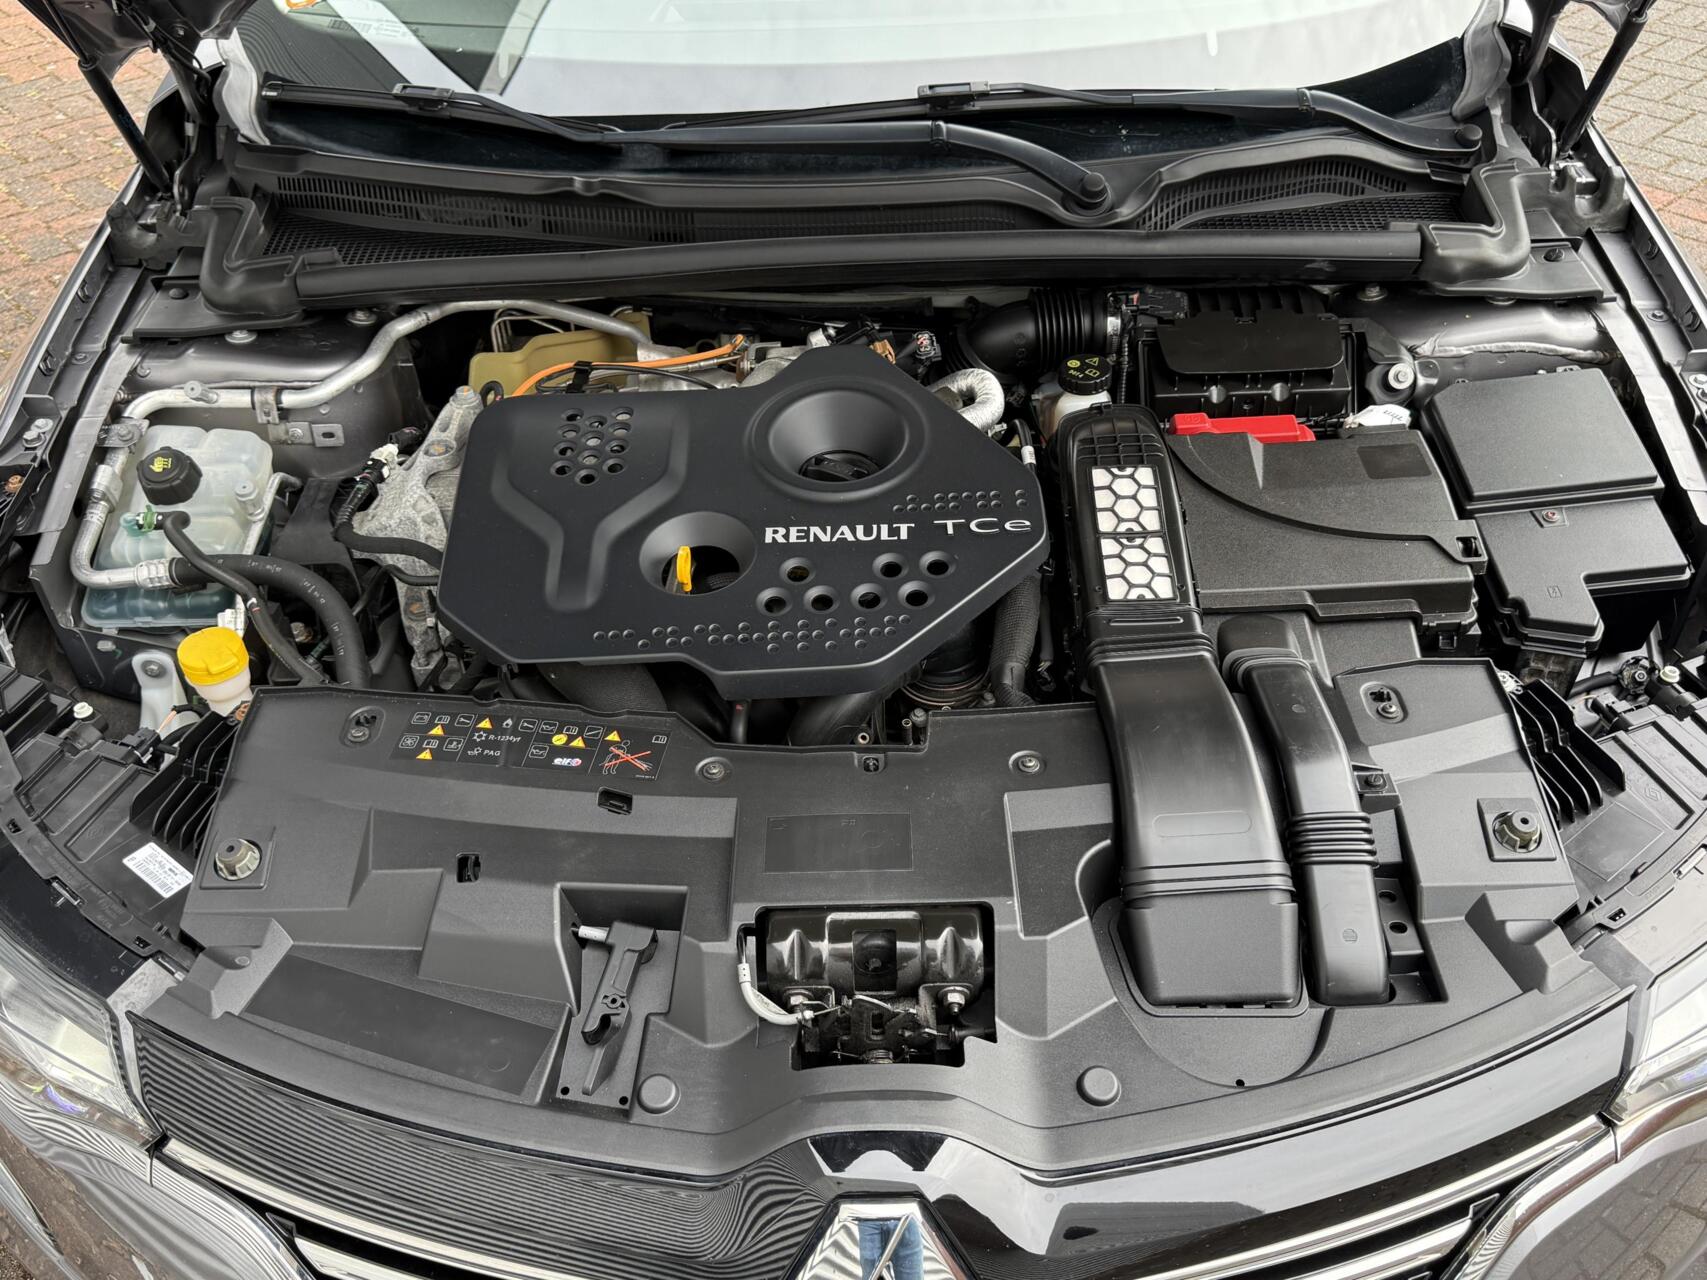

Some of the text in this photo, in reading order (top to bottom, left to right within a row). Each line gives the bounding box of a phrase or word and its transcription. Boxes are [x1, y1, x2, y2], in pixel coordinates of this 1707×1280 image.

[764, 517, 1032, 544] RENAULT TCe
[488, 734, 522, 743] R-1234yf
[483, 749, 501, 757] PAG
